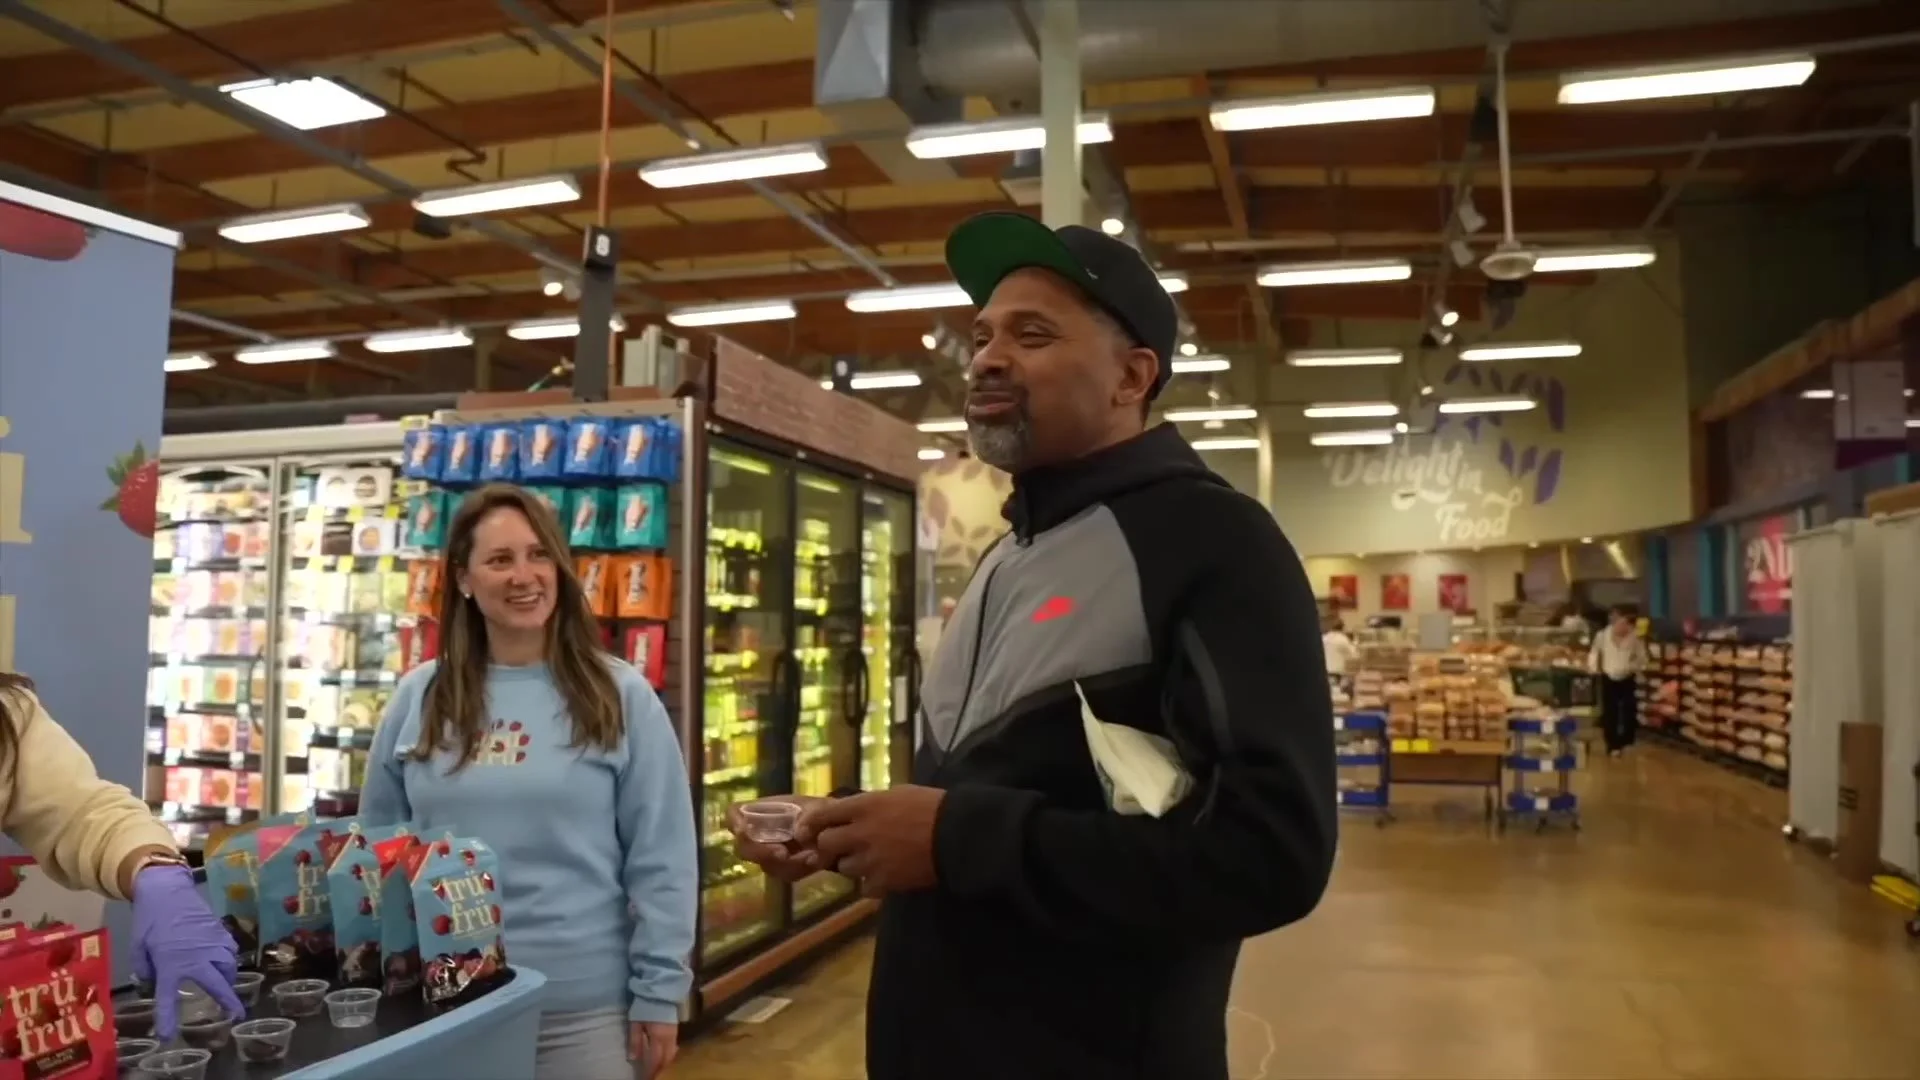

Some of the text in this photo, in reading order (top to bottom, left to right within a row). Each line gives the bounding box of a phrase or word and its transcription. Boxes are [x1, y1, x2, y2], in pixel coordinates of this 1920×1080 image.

[1322, 437, 1483, 510] Delight in
[1436, 486, 1523, 541] Food
[440, 869, 485, 903] trü
[450, 898, 497, 935] frü
[7, 967, 78, 1019] trü
[16, 1005, 86, 1060] frü
